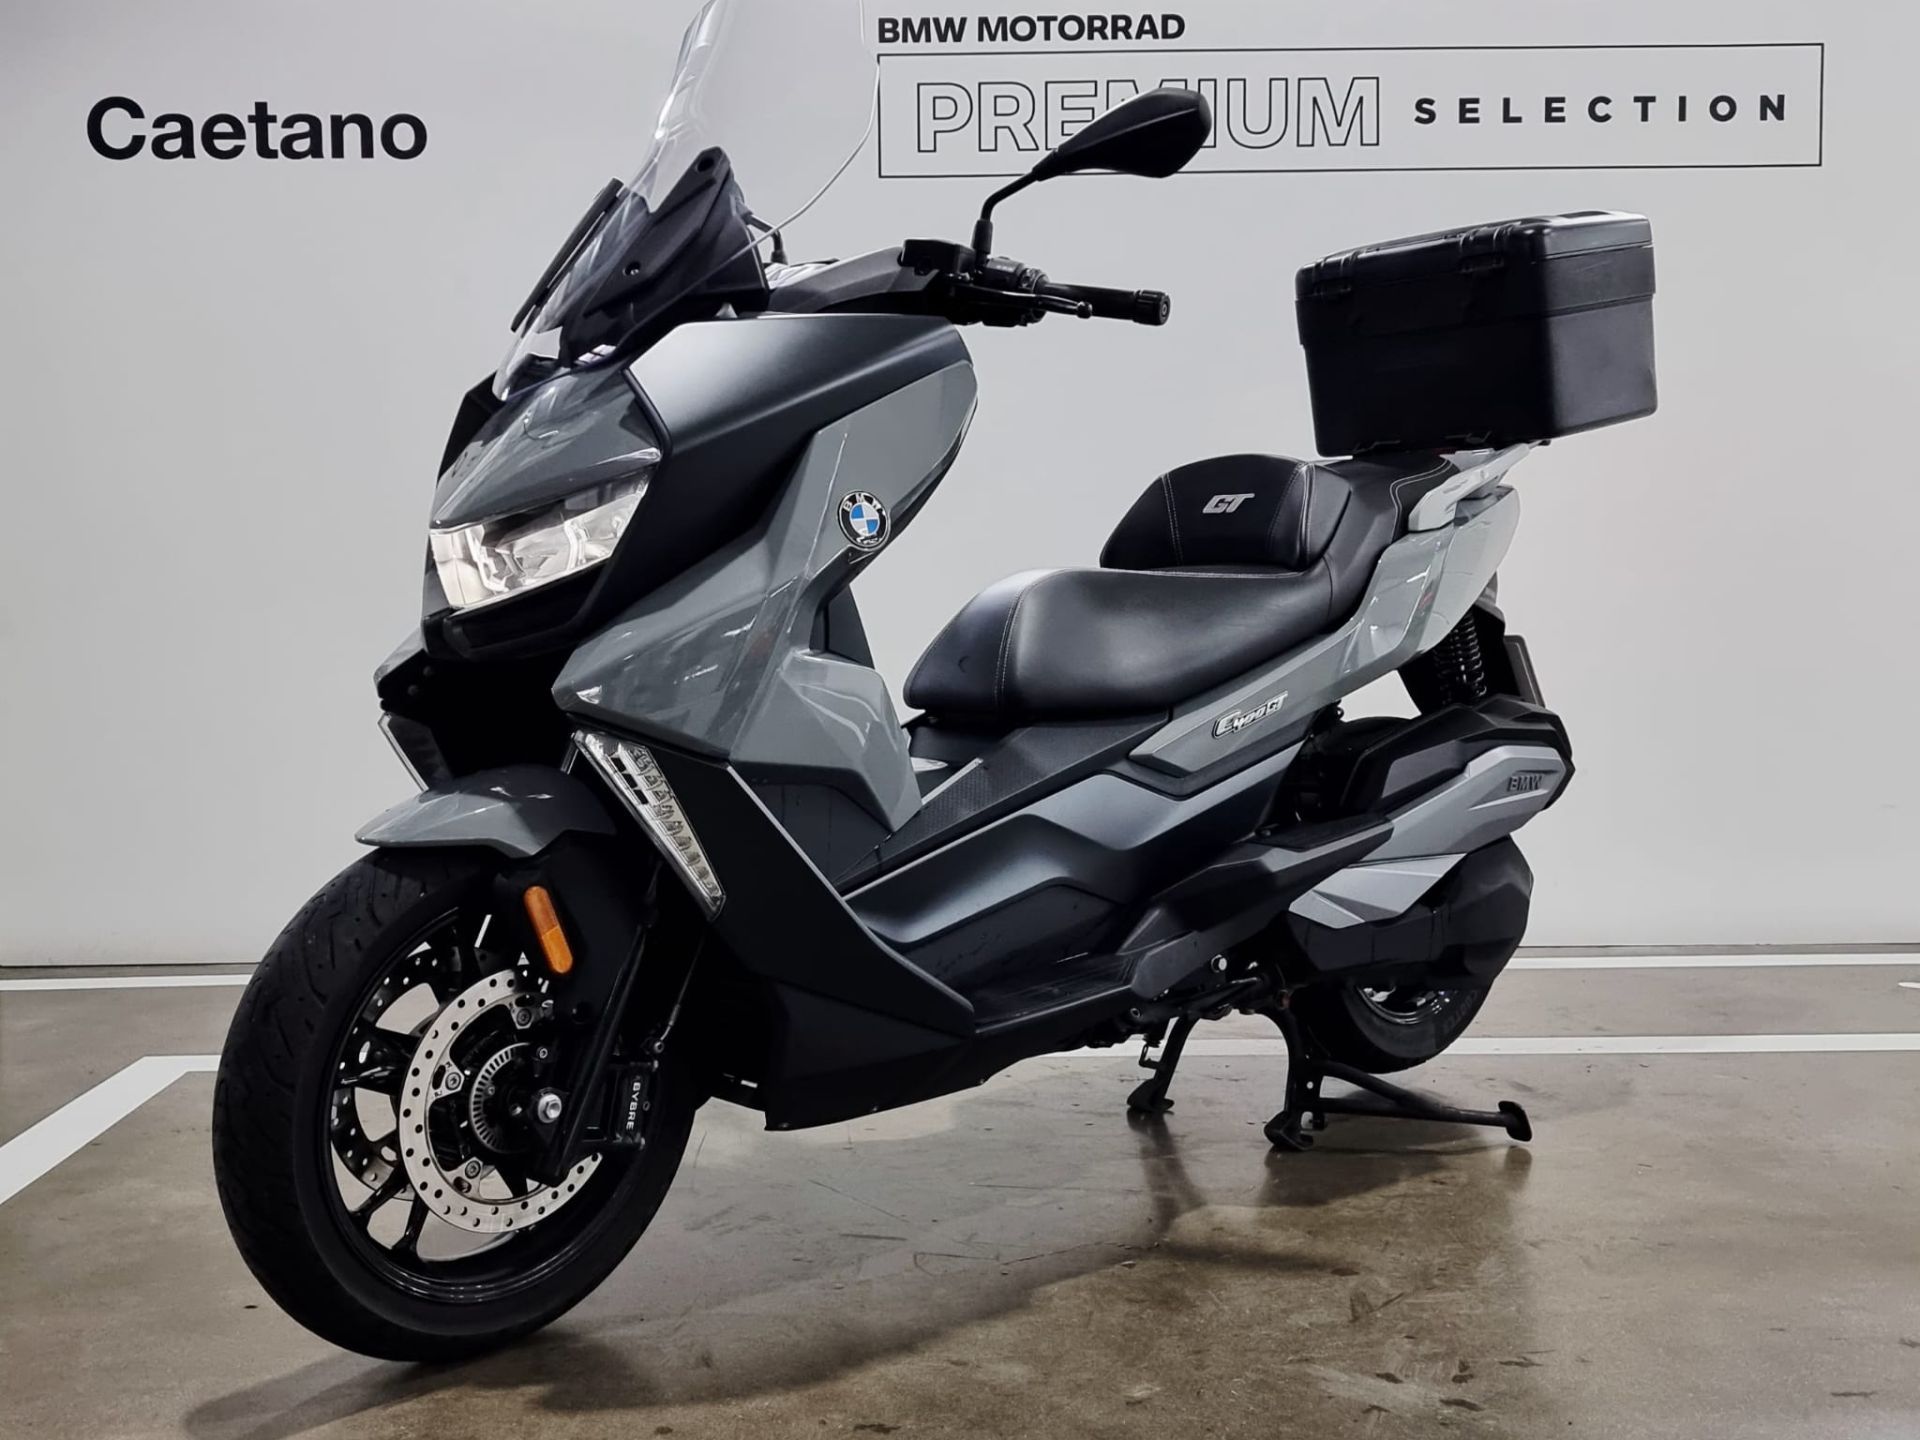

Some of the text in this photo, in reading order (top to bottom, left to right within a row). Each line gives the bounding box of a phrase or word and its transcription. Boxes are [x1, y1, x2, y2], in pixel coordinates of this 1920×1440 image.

[878, 13, 1186, 44] BMW MOTORRAD
[86, 96, 428, 161] Caetano
[916, 76, 1785, 153] PREIUM SELECTION
[1202, 493, 1255, 514] GT
[1506, 774, 1543, 792] BMW
[625, 1081, 642, 1131] BYBRE
